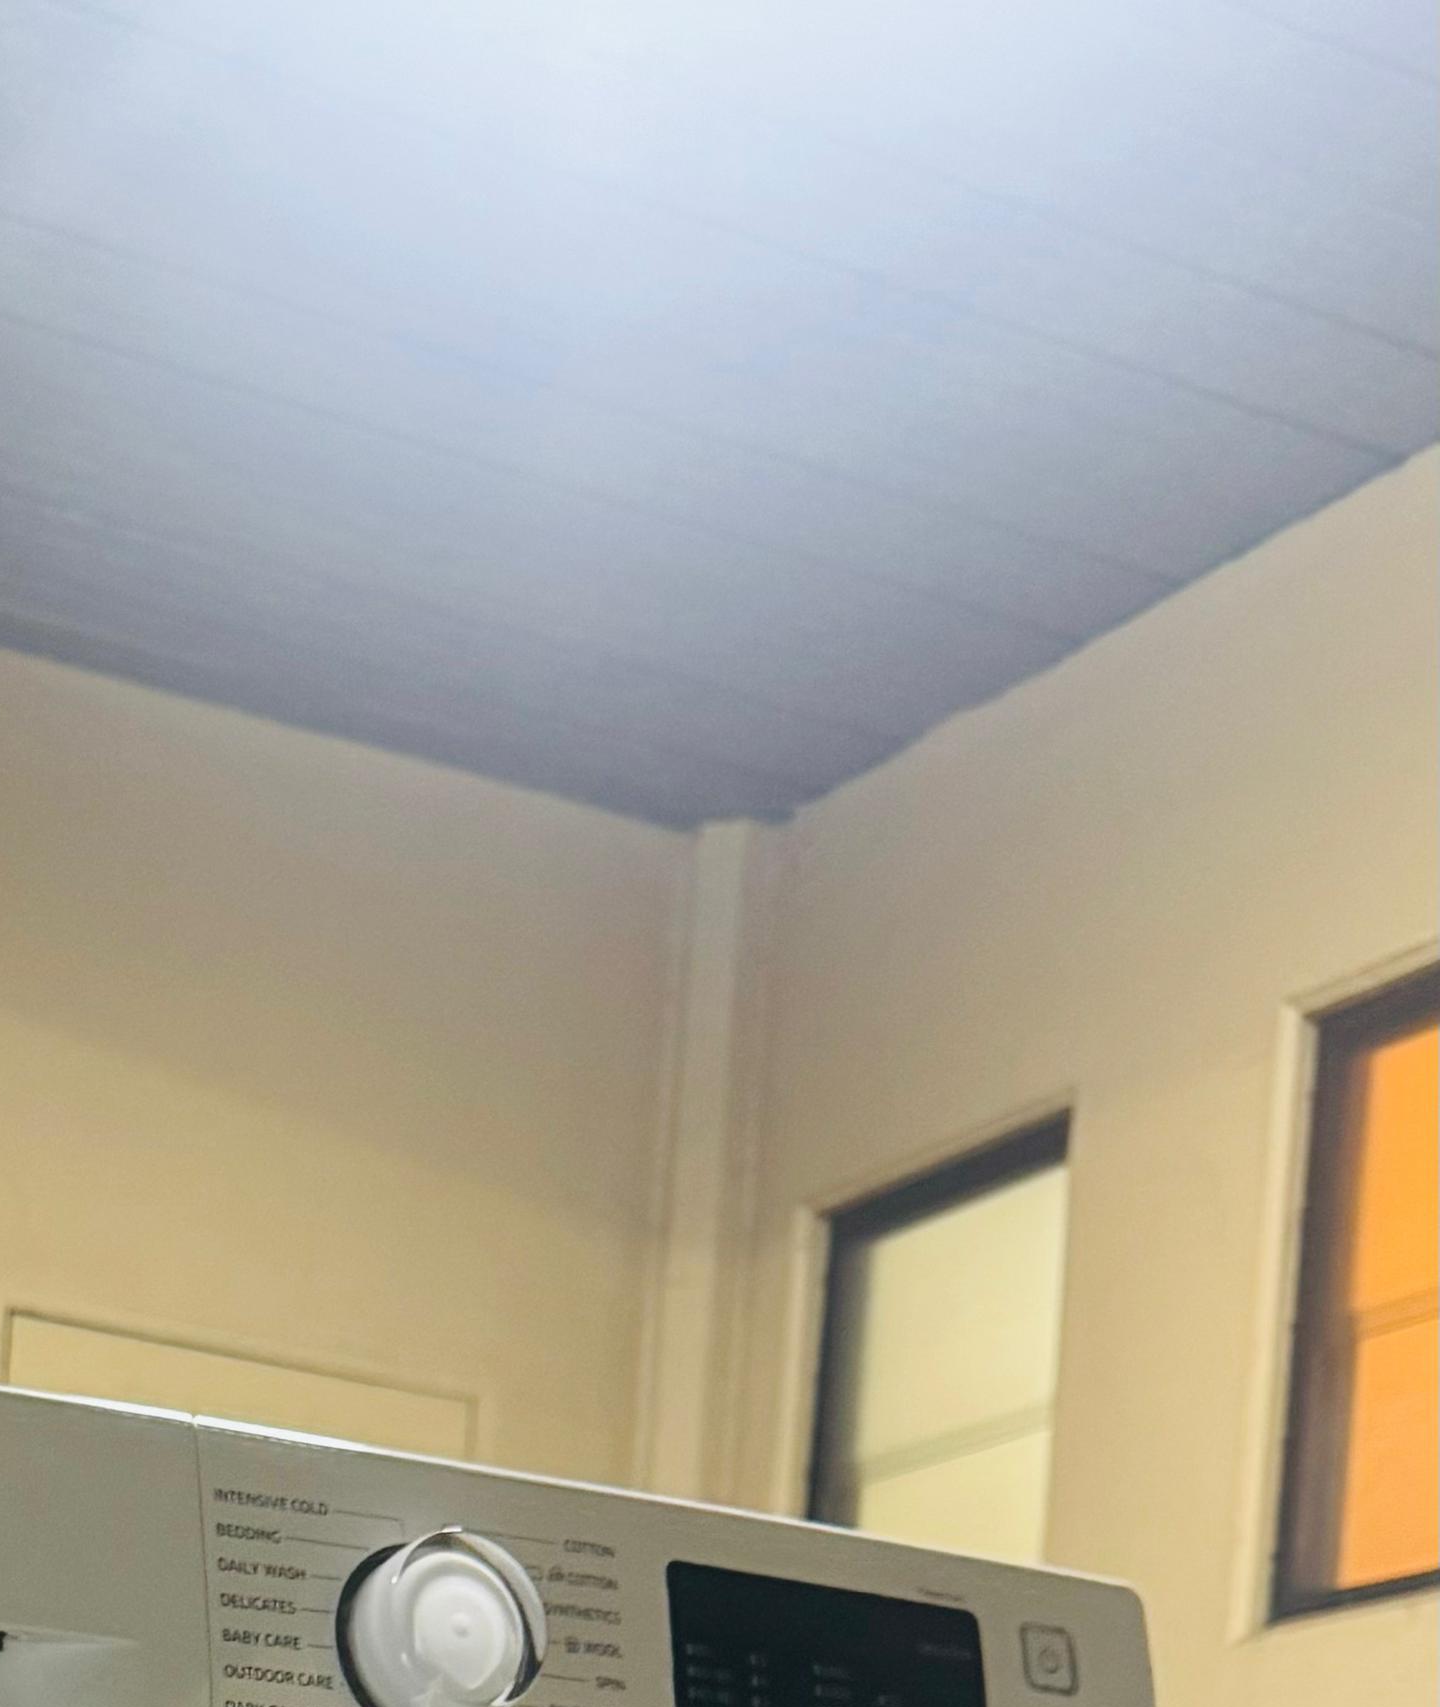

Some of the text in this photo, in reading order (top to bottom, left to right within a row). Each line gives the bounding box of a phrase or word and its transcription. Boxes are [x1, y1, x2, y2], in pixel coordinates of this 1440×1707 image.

[214, 1488, 328, 1515] INTENSIVE COLD
[216, 1522, 281, 1544] BEDDING
[218, 1557, 307, 1580] DAILY WASH
[220, 1593, 297, 1614] DELICATES
[222, 1628, 303, 1650] BABY CARE
[224, 1664, 334, 1690] OUTDOOR CARE
